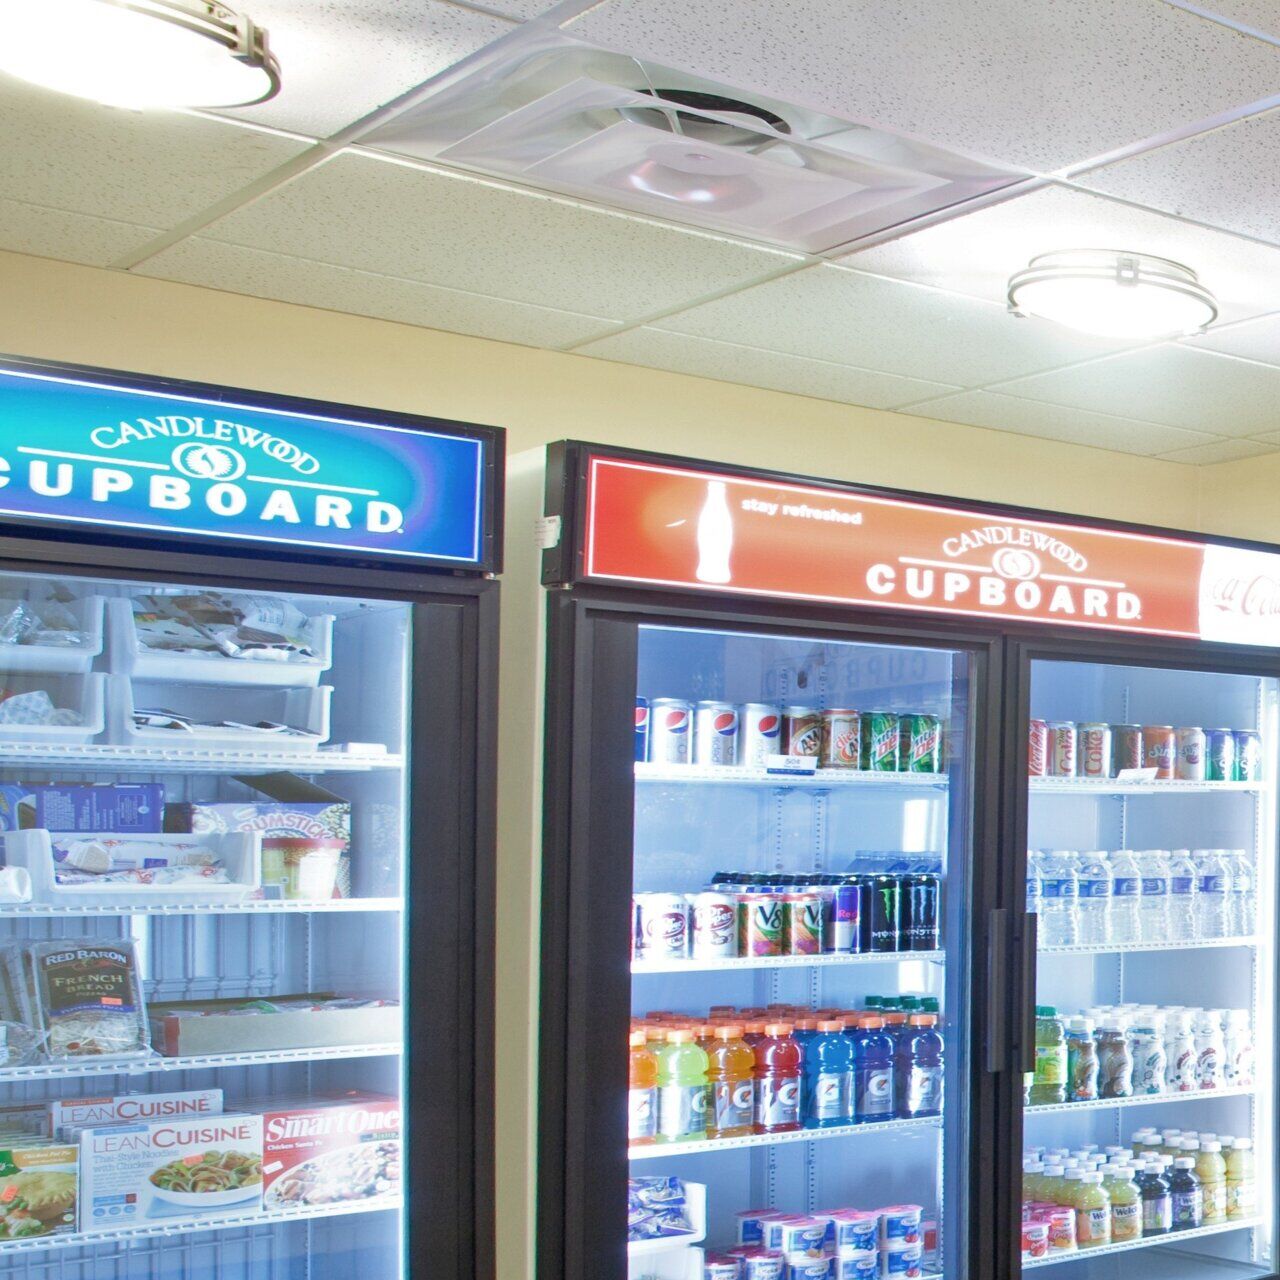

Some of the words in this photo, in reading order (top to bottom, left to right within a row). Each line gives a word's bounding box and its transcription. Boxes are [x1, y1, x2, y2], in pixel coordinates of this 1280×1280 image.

[90, 415, 320, 476] CANDLEWOOD
[742, 498, 779, 517] stay
[782, 503, 863, 525] refreshed
[942, 527, 1088, 573] CANDLEWOOD
[866, 564, 1142, 620] CUPBOARD
[757, 902, 782, 929] V8
[46, 952, 75, 966] RED
[77, 950, 127, 964] BARON
[55, 974, 123, 987] FRENCH
[67, 984, 115, 993] BREAD
[61, 1108, 115, 1124] LEAN
[117, 1098, 211, 1120] CUISINE
[266, 1112, 347, 1142] Smart
[348, 1109, 399, 1134] One
[93, 1136, 151, 1154] LEAN
[152, 1125, 251, 1149] CUISINE
